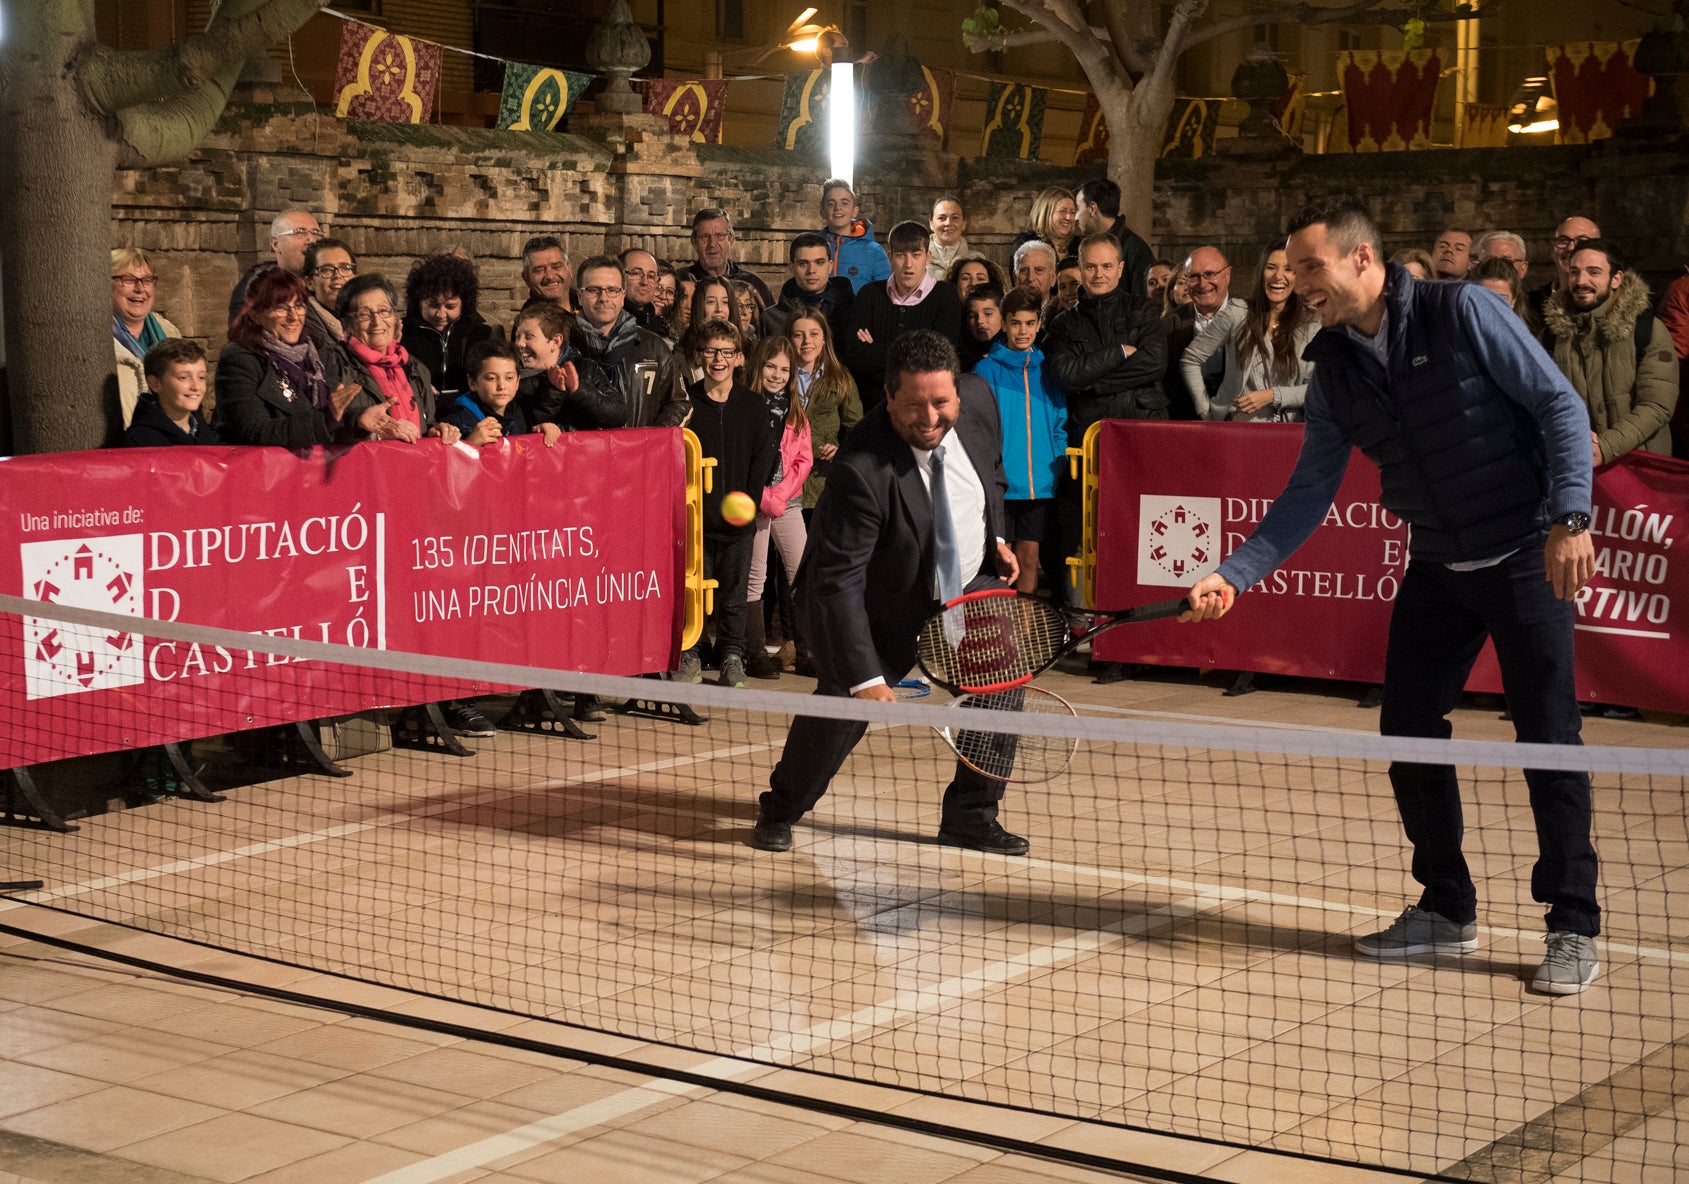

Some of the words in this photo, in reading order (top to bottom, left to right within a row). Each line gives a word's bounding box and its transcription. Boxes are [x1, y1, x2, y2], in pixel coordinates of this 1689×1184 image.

[644, 371, 656, 394] 7
[20, 513, 50, 532] Una
[53, 508, 120, 529] iniciativa
[123, 505, 144, 524] de:
[149, 502, 368, 571] DIPUTACIÓ
[1590, 504, 1674, 550] LLÓN,
[411, 537, 454, 570] 135
[463, 526, 599, 566] IDENTITATS,
[1382, 539, 1401, 566] E
[346, 566, 370, 603] E
[414, 588, 461, 623] UNA
[469, 573, 588, 617] PROVÍNCIA
[596, 567, 661, 605] ÚNICA
[1246, 568, 1399, 602] ASTELLÓ
[1574, 586, 1670, 624] RTIVO
